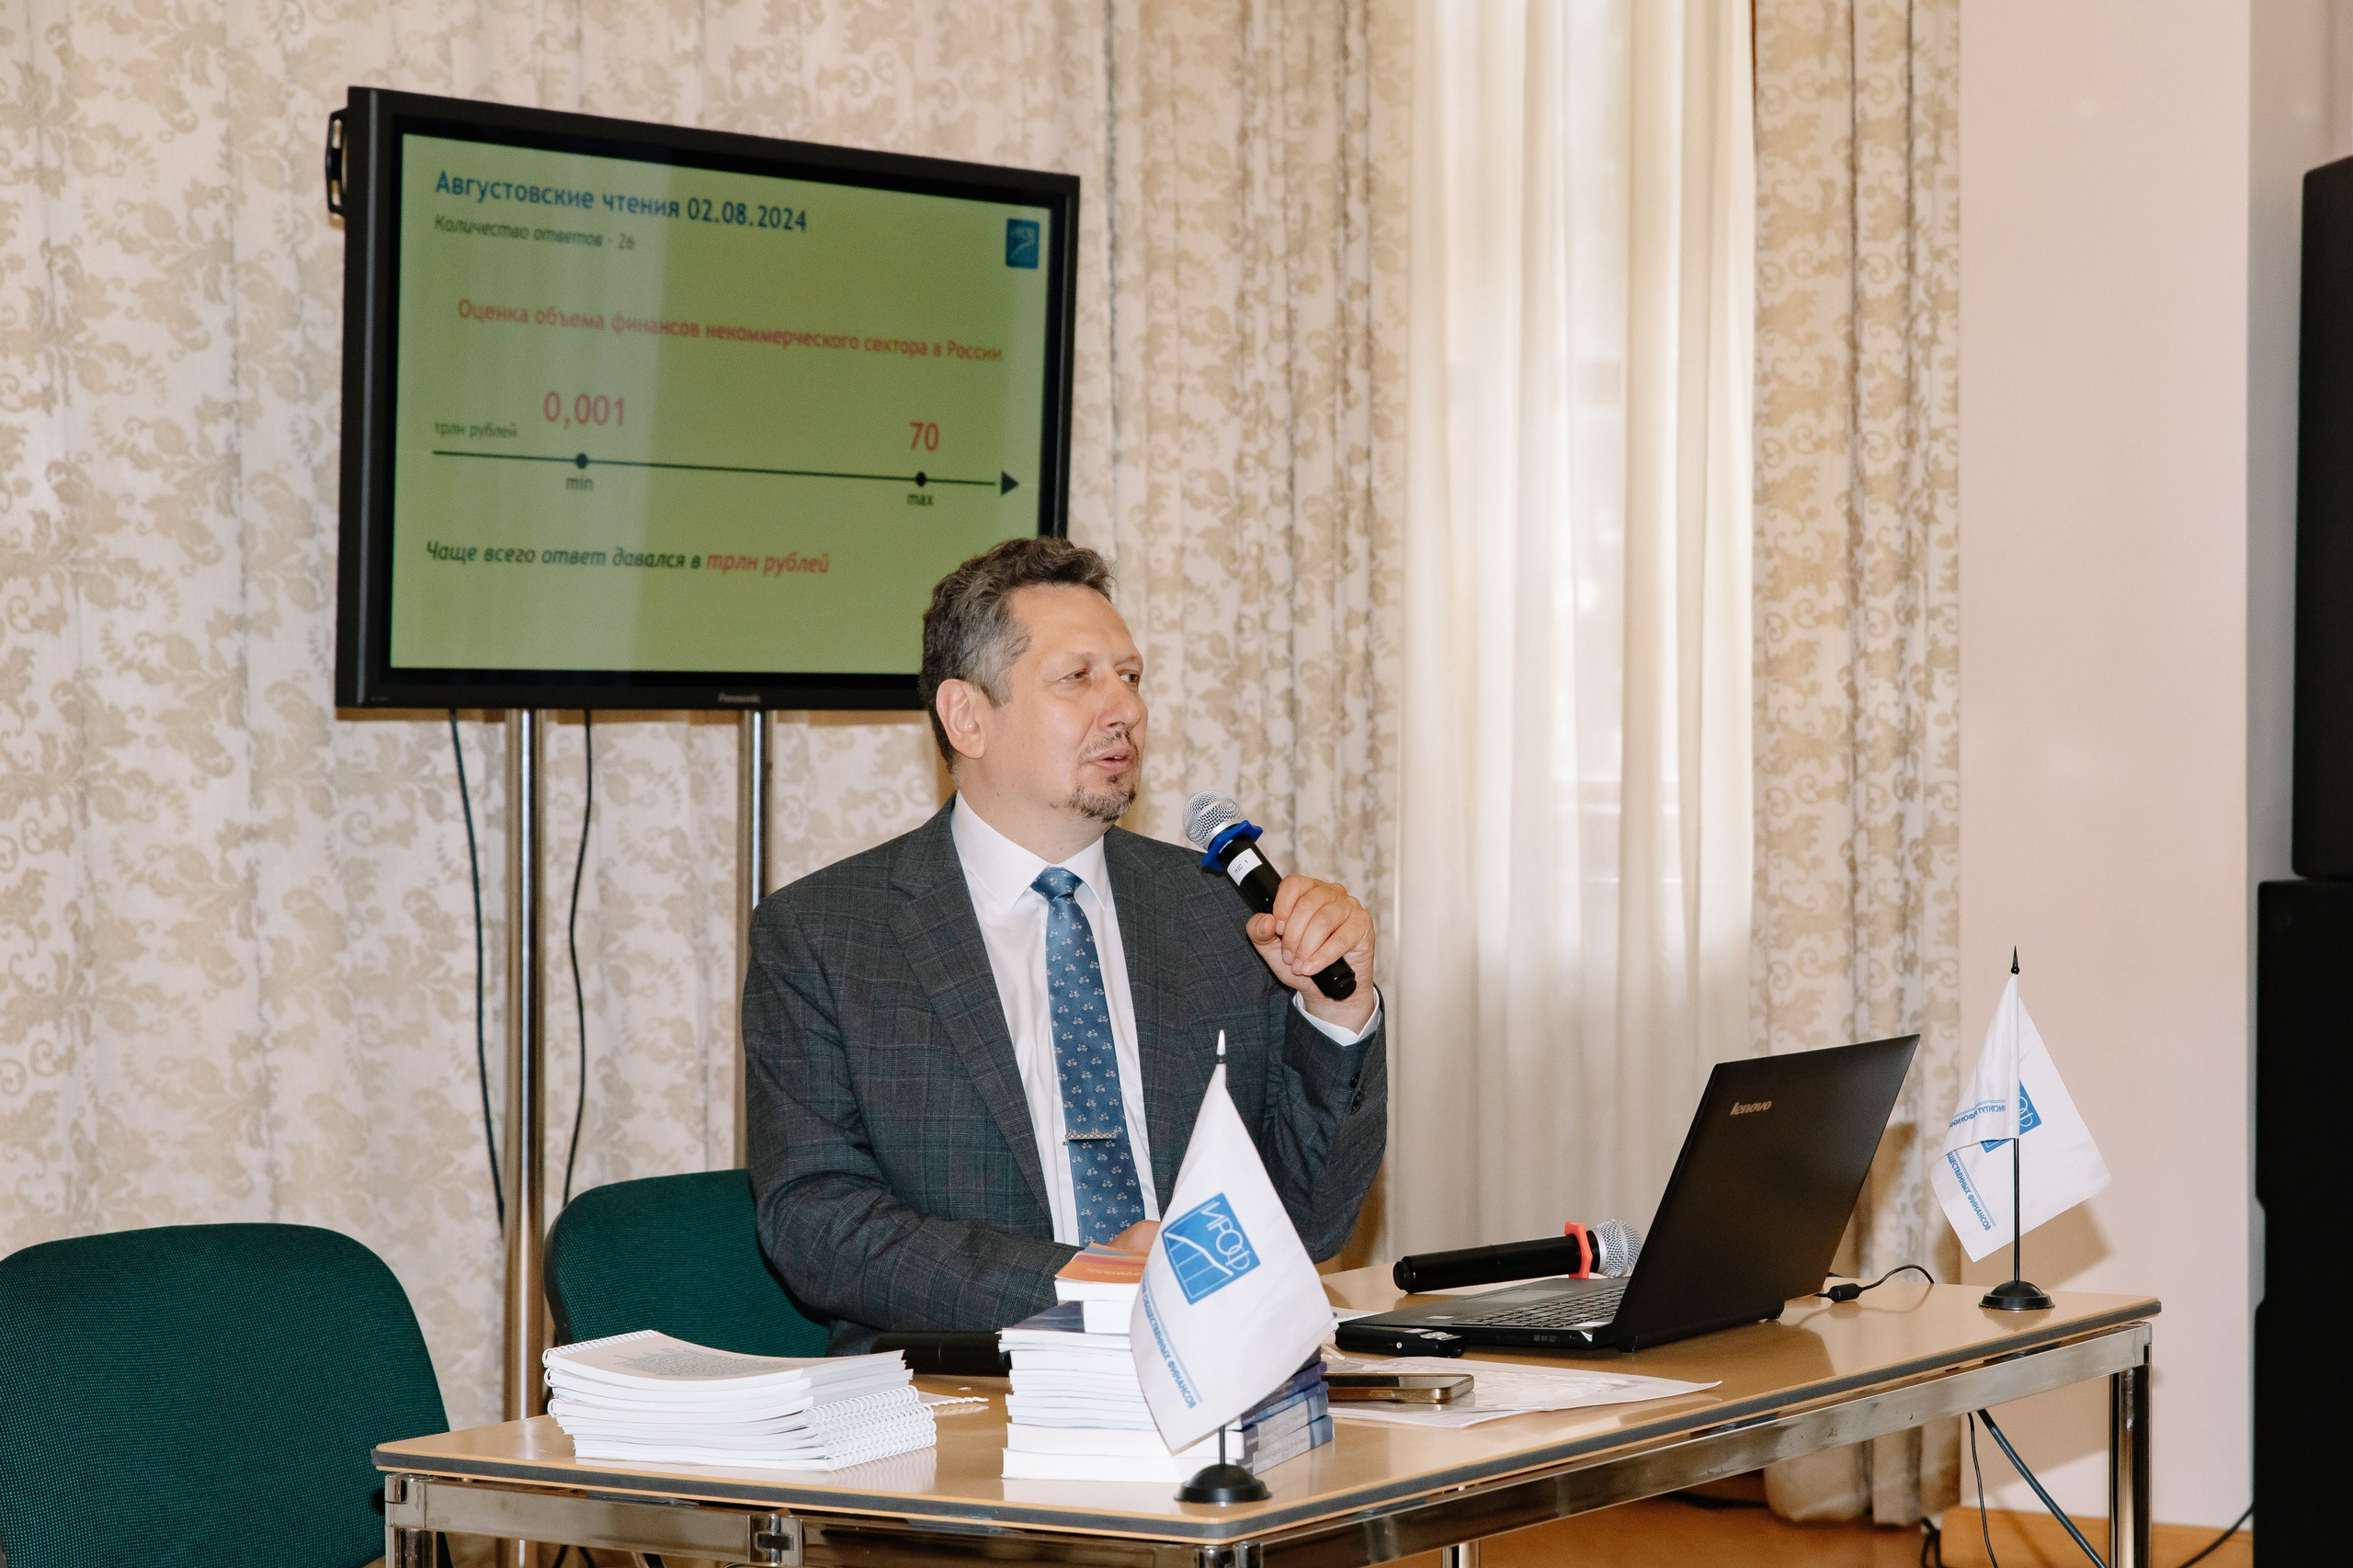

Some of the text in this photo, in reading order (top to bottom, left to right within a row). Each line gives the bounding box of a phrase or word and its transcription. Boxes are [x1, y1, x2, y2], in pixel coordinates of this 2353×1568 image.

[435, 170, 808, 232] Августовские чтения 02.08.2024
[433, 214, 529, 241] Количество
[533, 227, 603, 248] ответов
[617, 232, 635, 251] 26
[458, 298, 1003, 361] Оценка объема финансов некоммерческого сектора в России
[543, 392, 625, 430] 0,001
[434, 421, 518, 439] трлн рублей
[909, 421, 939, 452] 70
[565, 475, 594, 492] min
[906, 492, 934, 506] max
[426, 540, 830, 577] Чаще всего ответ давался в трлн рублей
[1233, 863, 1244, 875] MIC
[1968, 1194, 1992, 1231] ФИНАНСОВ
[1142, 1294, 1197, 1409] ОБЩЕСТВЕННЫХ ФИНАНСОВ
